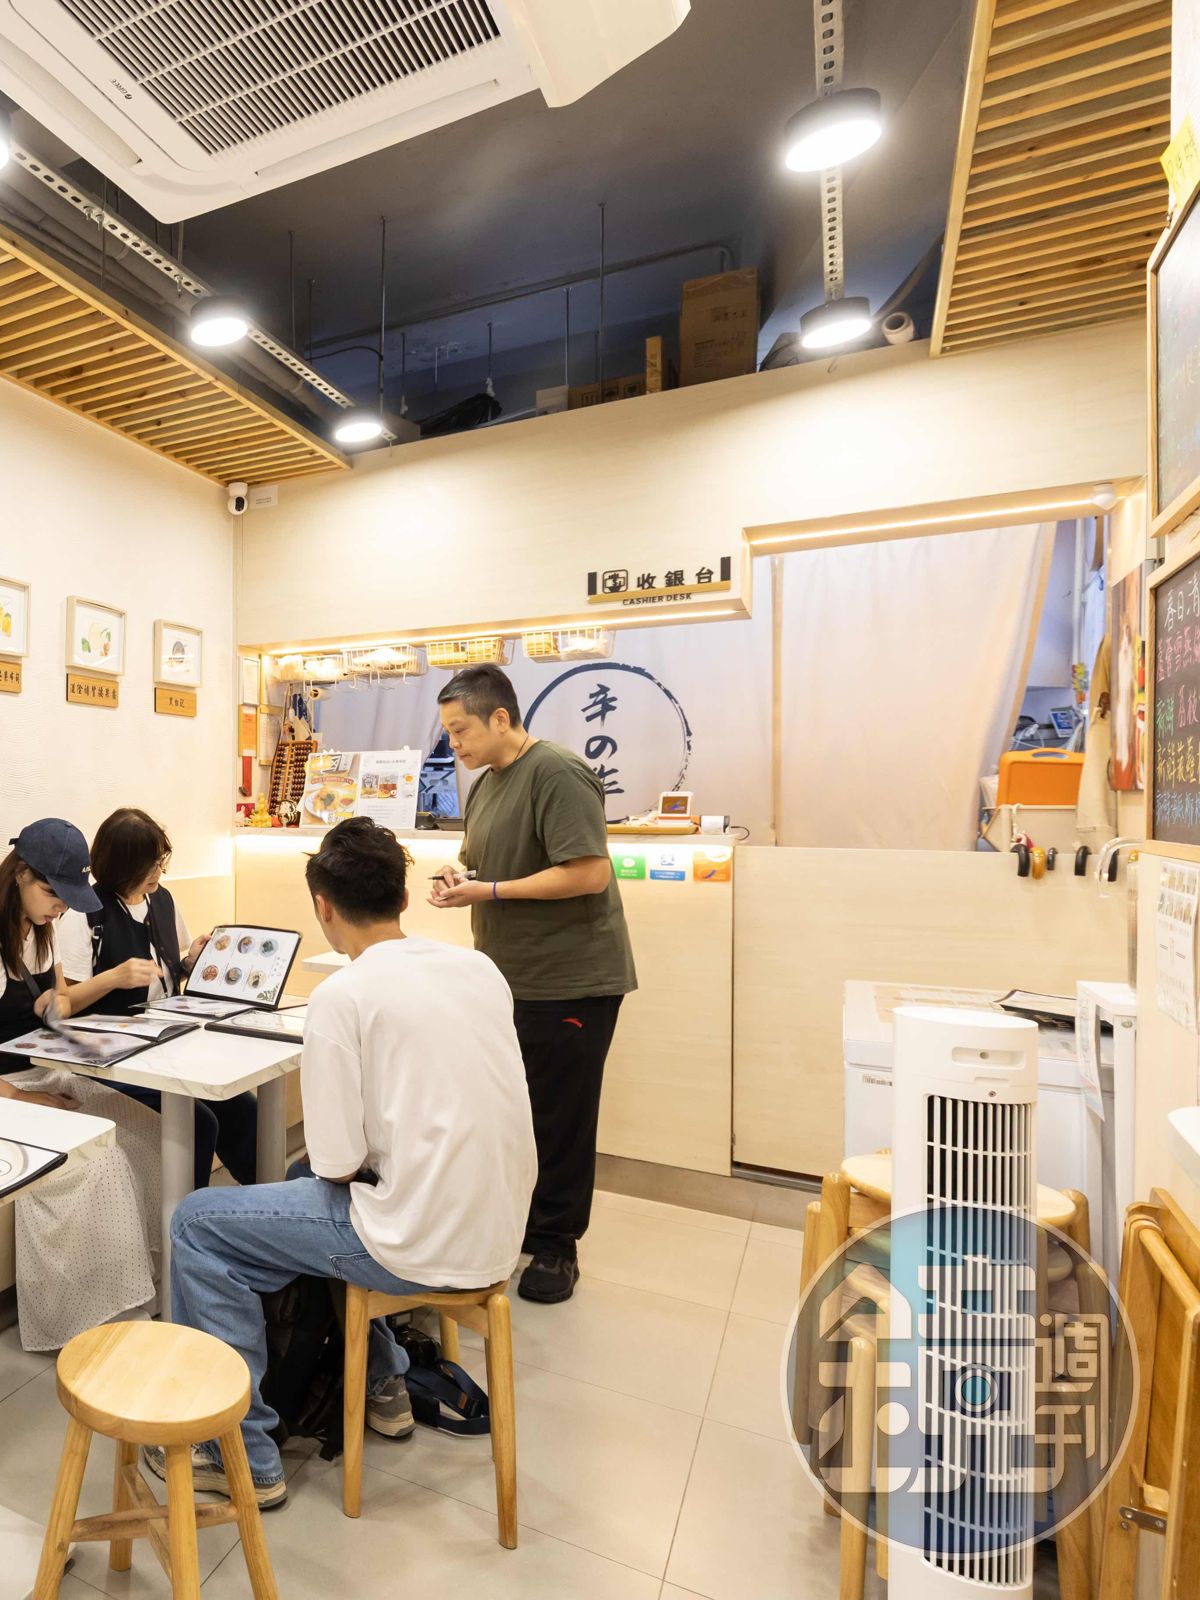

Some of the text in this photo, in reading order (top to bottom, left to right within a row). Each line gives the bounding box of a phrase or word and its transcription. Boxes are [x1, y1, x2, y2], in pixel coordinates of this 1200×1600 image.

[636, 567, 714, 590] 收銀台
[622, 592, 693, 606] CASHIER DESK
